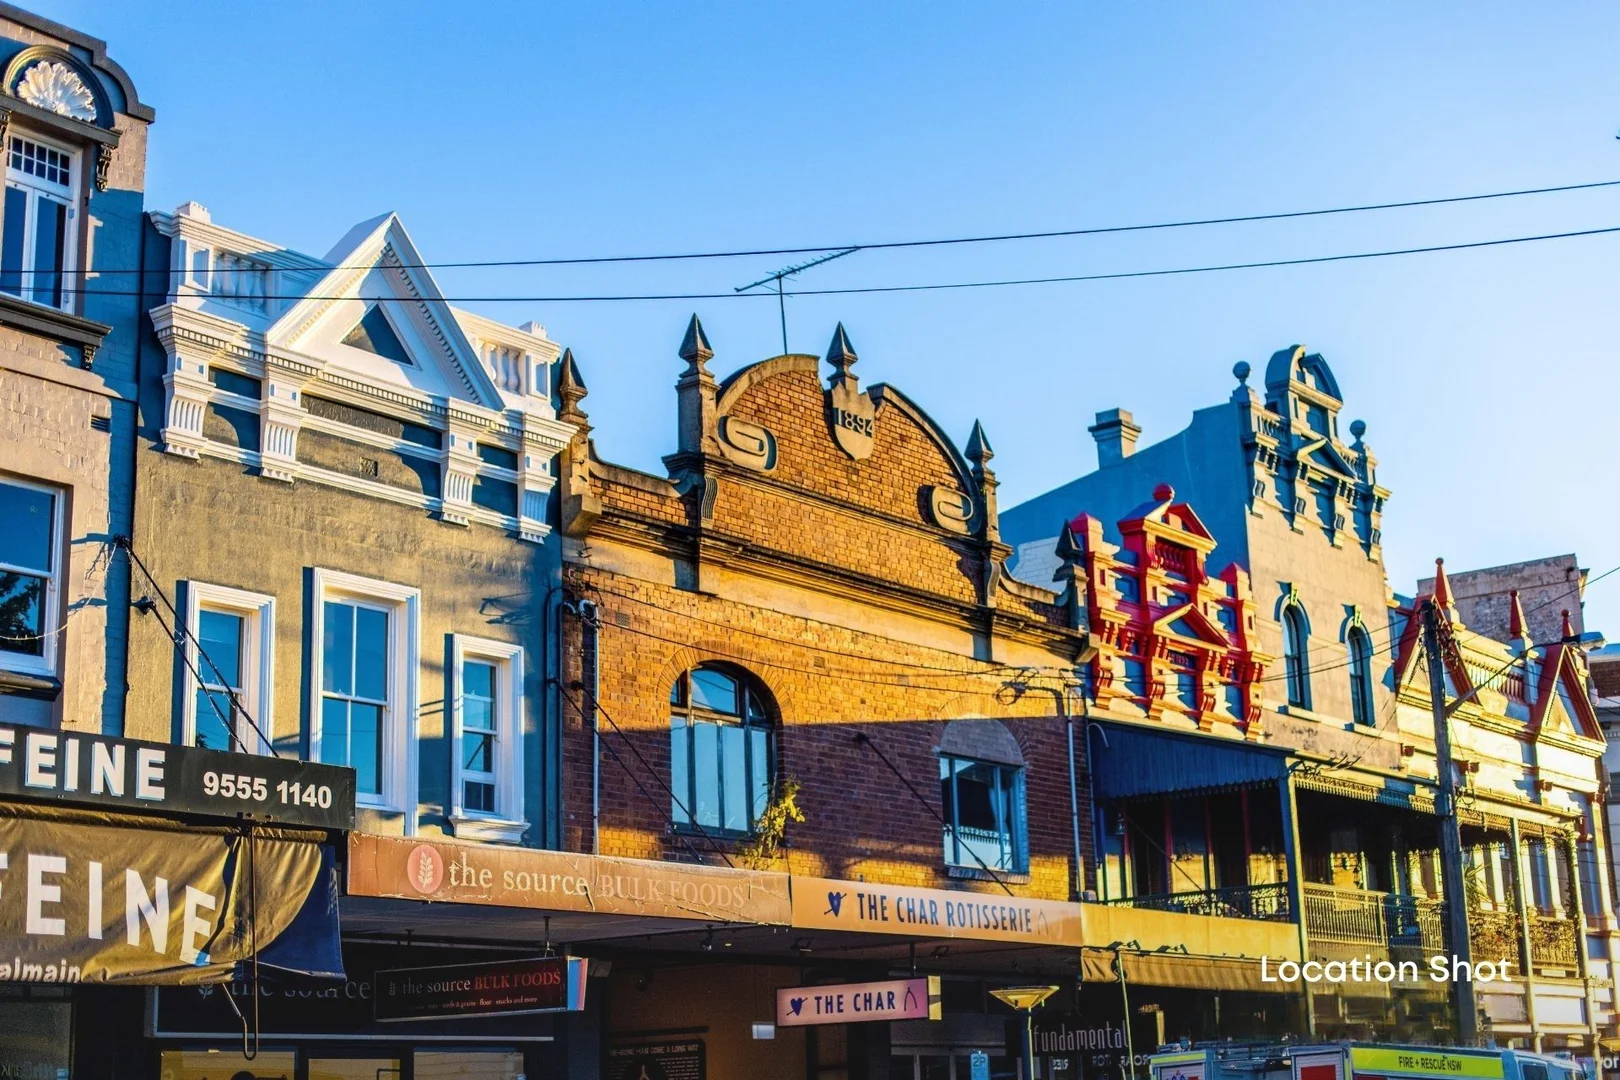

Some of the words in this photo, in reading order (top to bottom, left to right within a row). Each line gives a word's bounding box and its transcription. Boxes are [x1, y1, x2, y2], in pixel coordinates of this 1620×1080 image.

[837, 408, 873, 436] 1894
[203, 771, 268, 802] 9555
[276, 780, 332, 809] 1140
[449, 851, 493, 888] the
[503, 869, 591, 896] source
[599, 874, 665, 902] BULK
[668, 879, 745, 908] FOODS
[0, 852, 216, 967] EINE
[857, 892, 888, 922] THE
[896, 896, 939, 926] CHAR
[946, 900, 1032, 933] ROTISSERIE
[402, 976, 423, 995] the
[427, 978, 471, 993] source
[475, 975, 511, 990] BULK
[513, 969, 562, 987] FOODS
[814, 994, 844, 1015] THE
[853, 990, 896, 1012] CHAR
[1033, 1019, 1130, 1052] fundamental
[973, 1056, 987, 1068] 2P
[1398, 1055, 1414, 1068] FIRE
[1420, 1057, 1447, 1070] RESCUE
[1447, 1059, 1462, 1071] NSW
